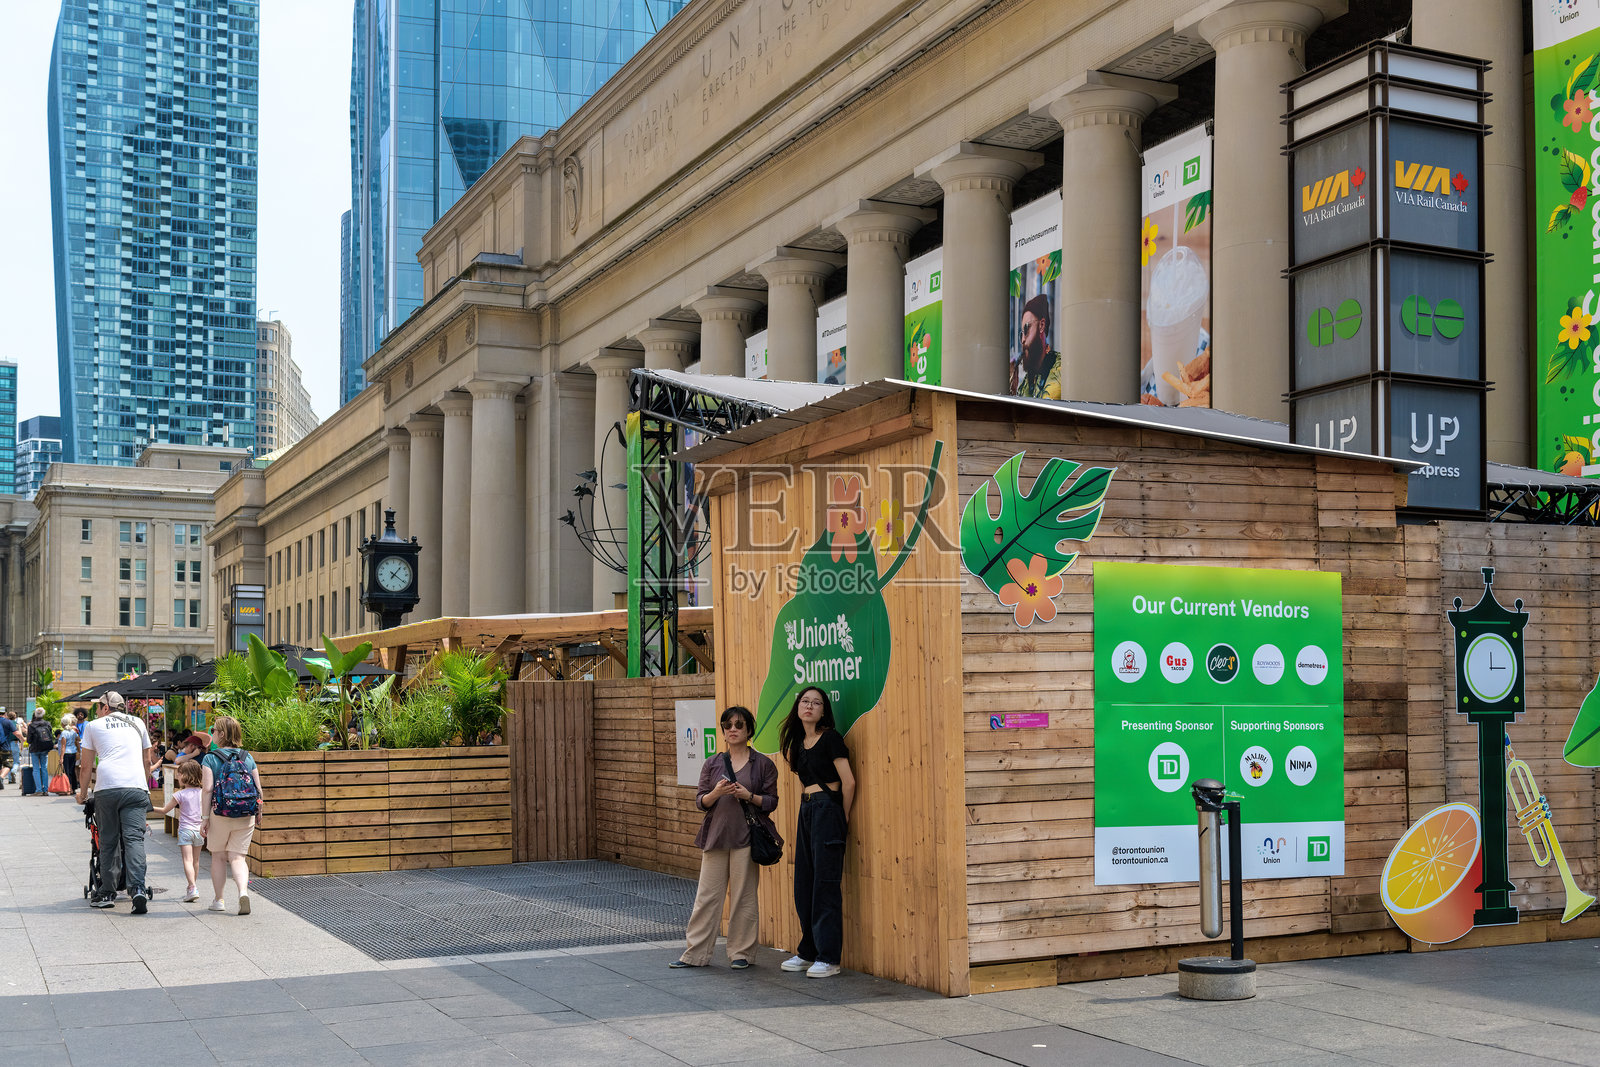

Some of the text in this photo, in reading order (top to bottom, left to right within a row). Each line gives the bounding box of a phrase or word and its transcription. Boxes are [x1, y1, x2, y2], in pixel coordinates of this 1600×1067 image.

[1559, 11, 1579, 24] Union
[1395, 160, 1451, 196] VIA
[1302, 169, 1350, 213] VIA
[1395, 191, 1468, 213] VIA Rail Canada
[1303, 195, 1365, 227] VIA Rail Canada
[1315, 415, 1358, 452] UP
[1410, 412, 1461, 456] UP
[1411, 464, 1461, 479] xpress
[1132, 594, 1310, 620] Our Current Vendors
[793, 617, 838, 650] Union
[1166, 655, 1187, 667] Gus
[793, 653, 863, 685] Summer
[830, 690, 840, 702] TD
[1121, 720, 1214, 733] Presenting Sponsor
[1230, 720, 1324, 733] Supporting Sponsors
[1245, 752, 1269, 764] MALIBU
[1289, 759, 1313, 772] NINJA
[1159, 759, 1179, 775] TD
[1112, 845, 1165, 855] @torontounion
[1309, 840, 1328, 857] TD
[1111, 855, 1169, 865] torontounion.ca
[1263, 856, 1281, 864] Union
